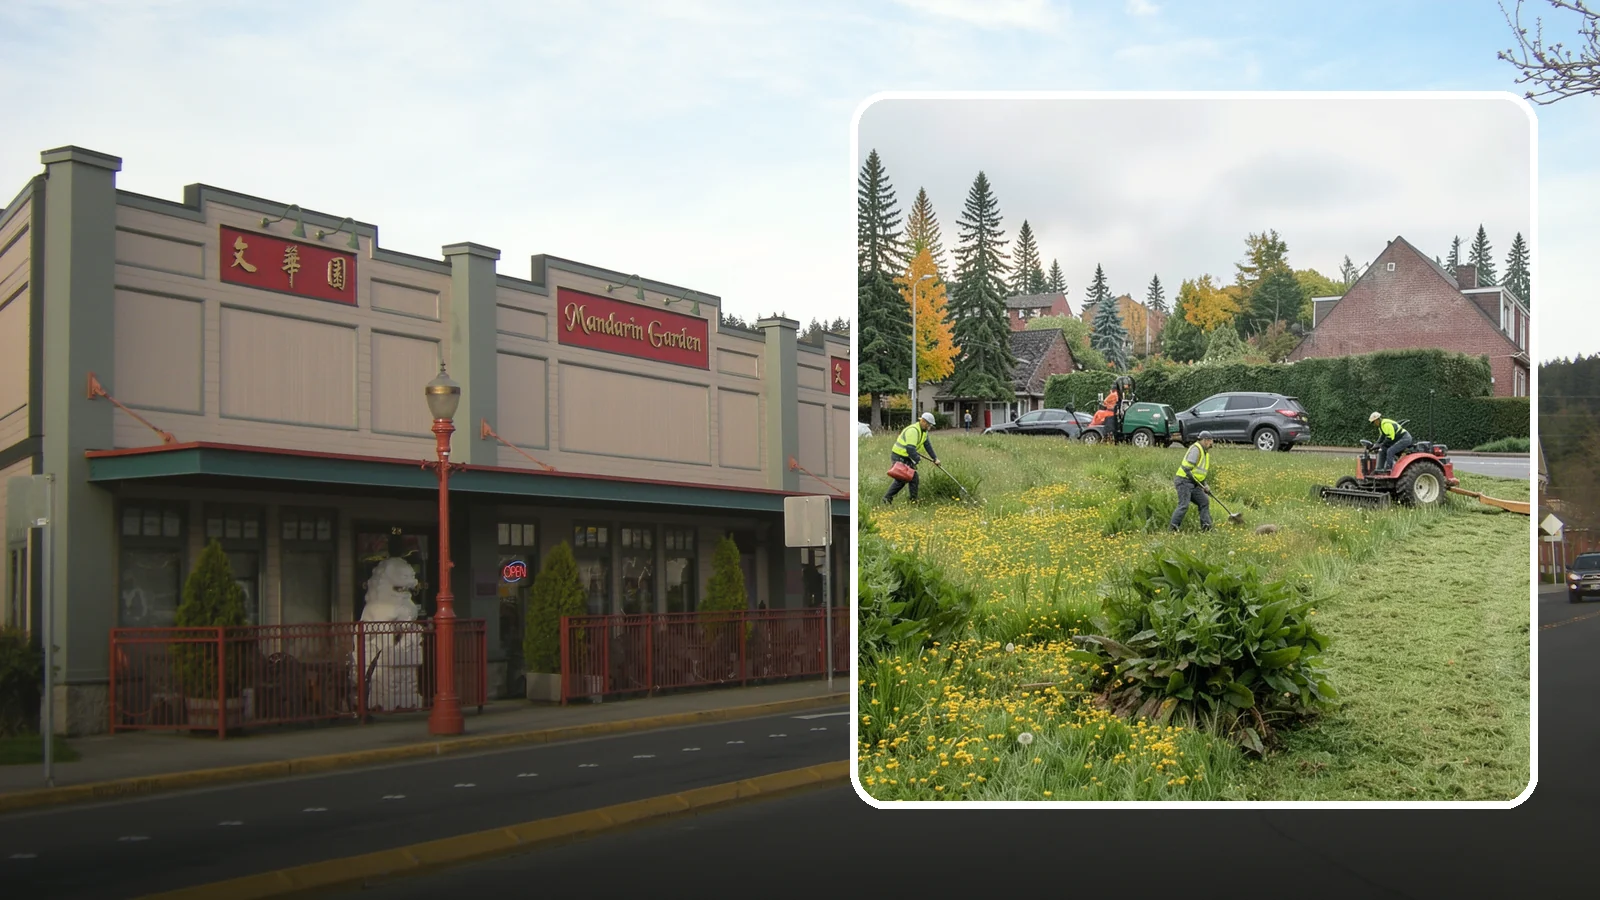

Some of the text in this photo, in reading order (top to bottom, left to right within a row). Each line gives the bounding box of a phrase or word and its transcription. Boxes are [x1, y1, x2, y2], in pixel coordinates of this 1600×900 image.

[564, 302, 702, 352] Mandarin Garden
[503, 565, 527, 578] OPEN
